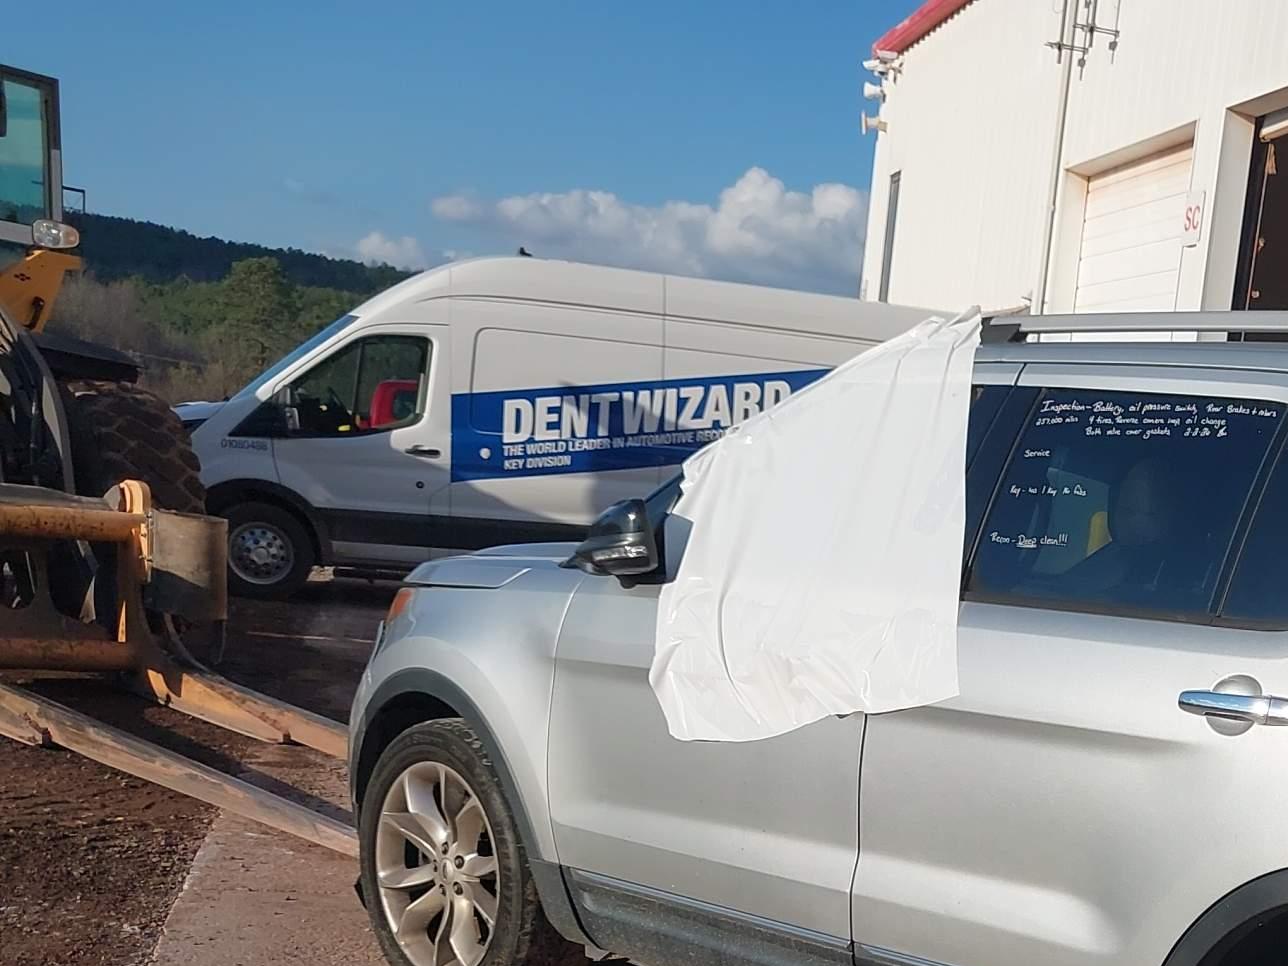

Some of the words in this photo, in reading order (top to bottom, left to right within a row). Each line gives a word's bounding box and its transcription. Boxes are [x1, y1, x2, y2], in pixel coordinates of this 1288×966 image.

[1184, 205, 1201, 232] SC
[1185, 415, 1198, 425] oil
[1200, 416, 1227, 429] change
[503, 444, 525, 457] THE
[526, 440, 567, 455] WORLD
[568, 437, 610, 452] LEADER
[612, 436, 625, 448] IN
[627, 430, 695, 448] AUTOMOTIVE
[1023, 448, 1051, 458] Service
[504, 458, 525, 471] KEY
[526, 455, 572, 470] DIVISION
